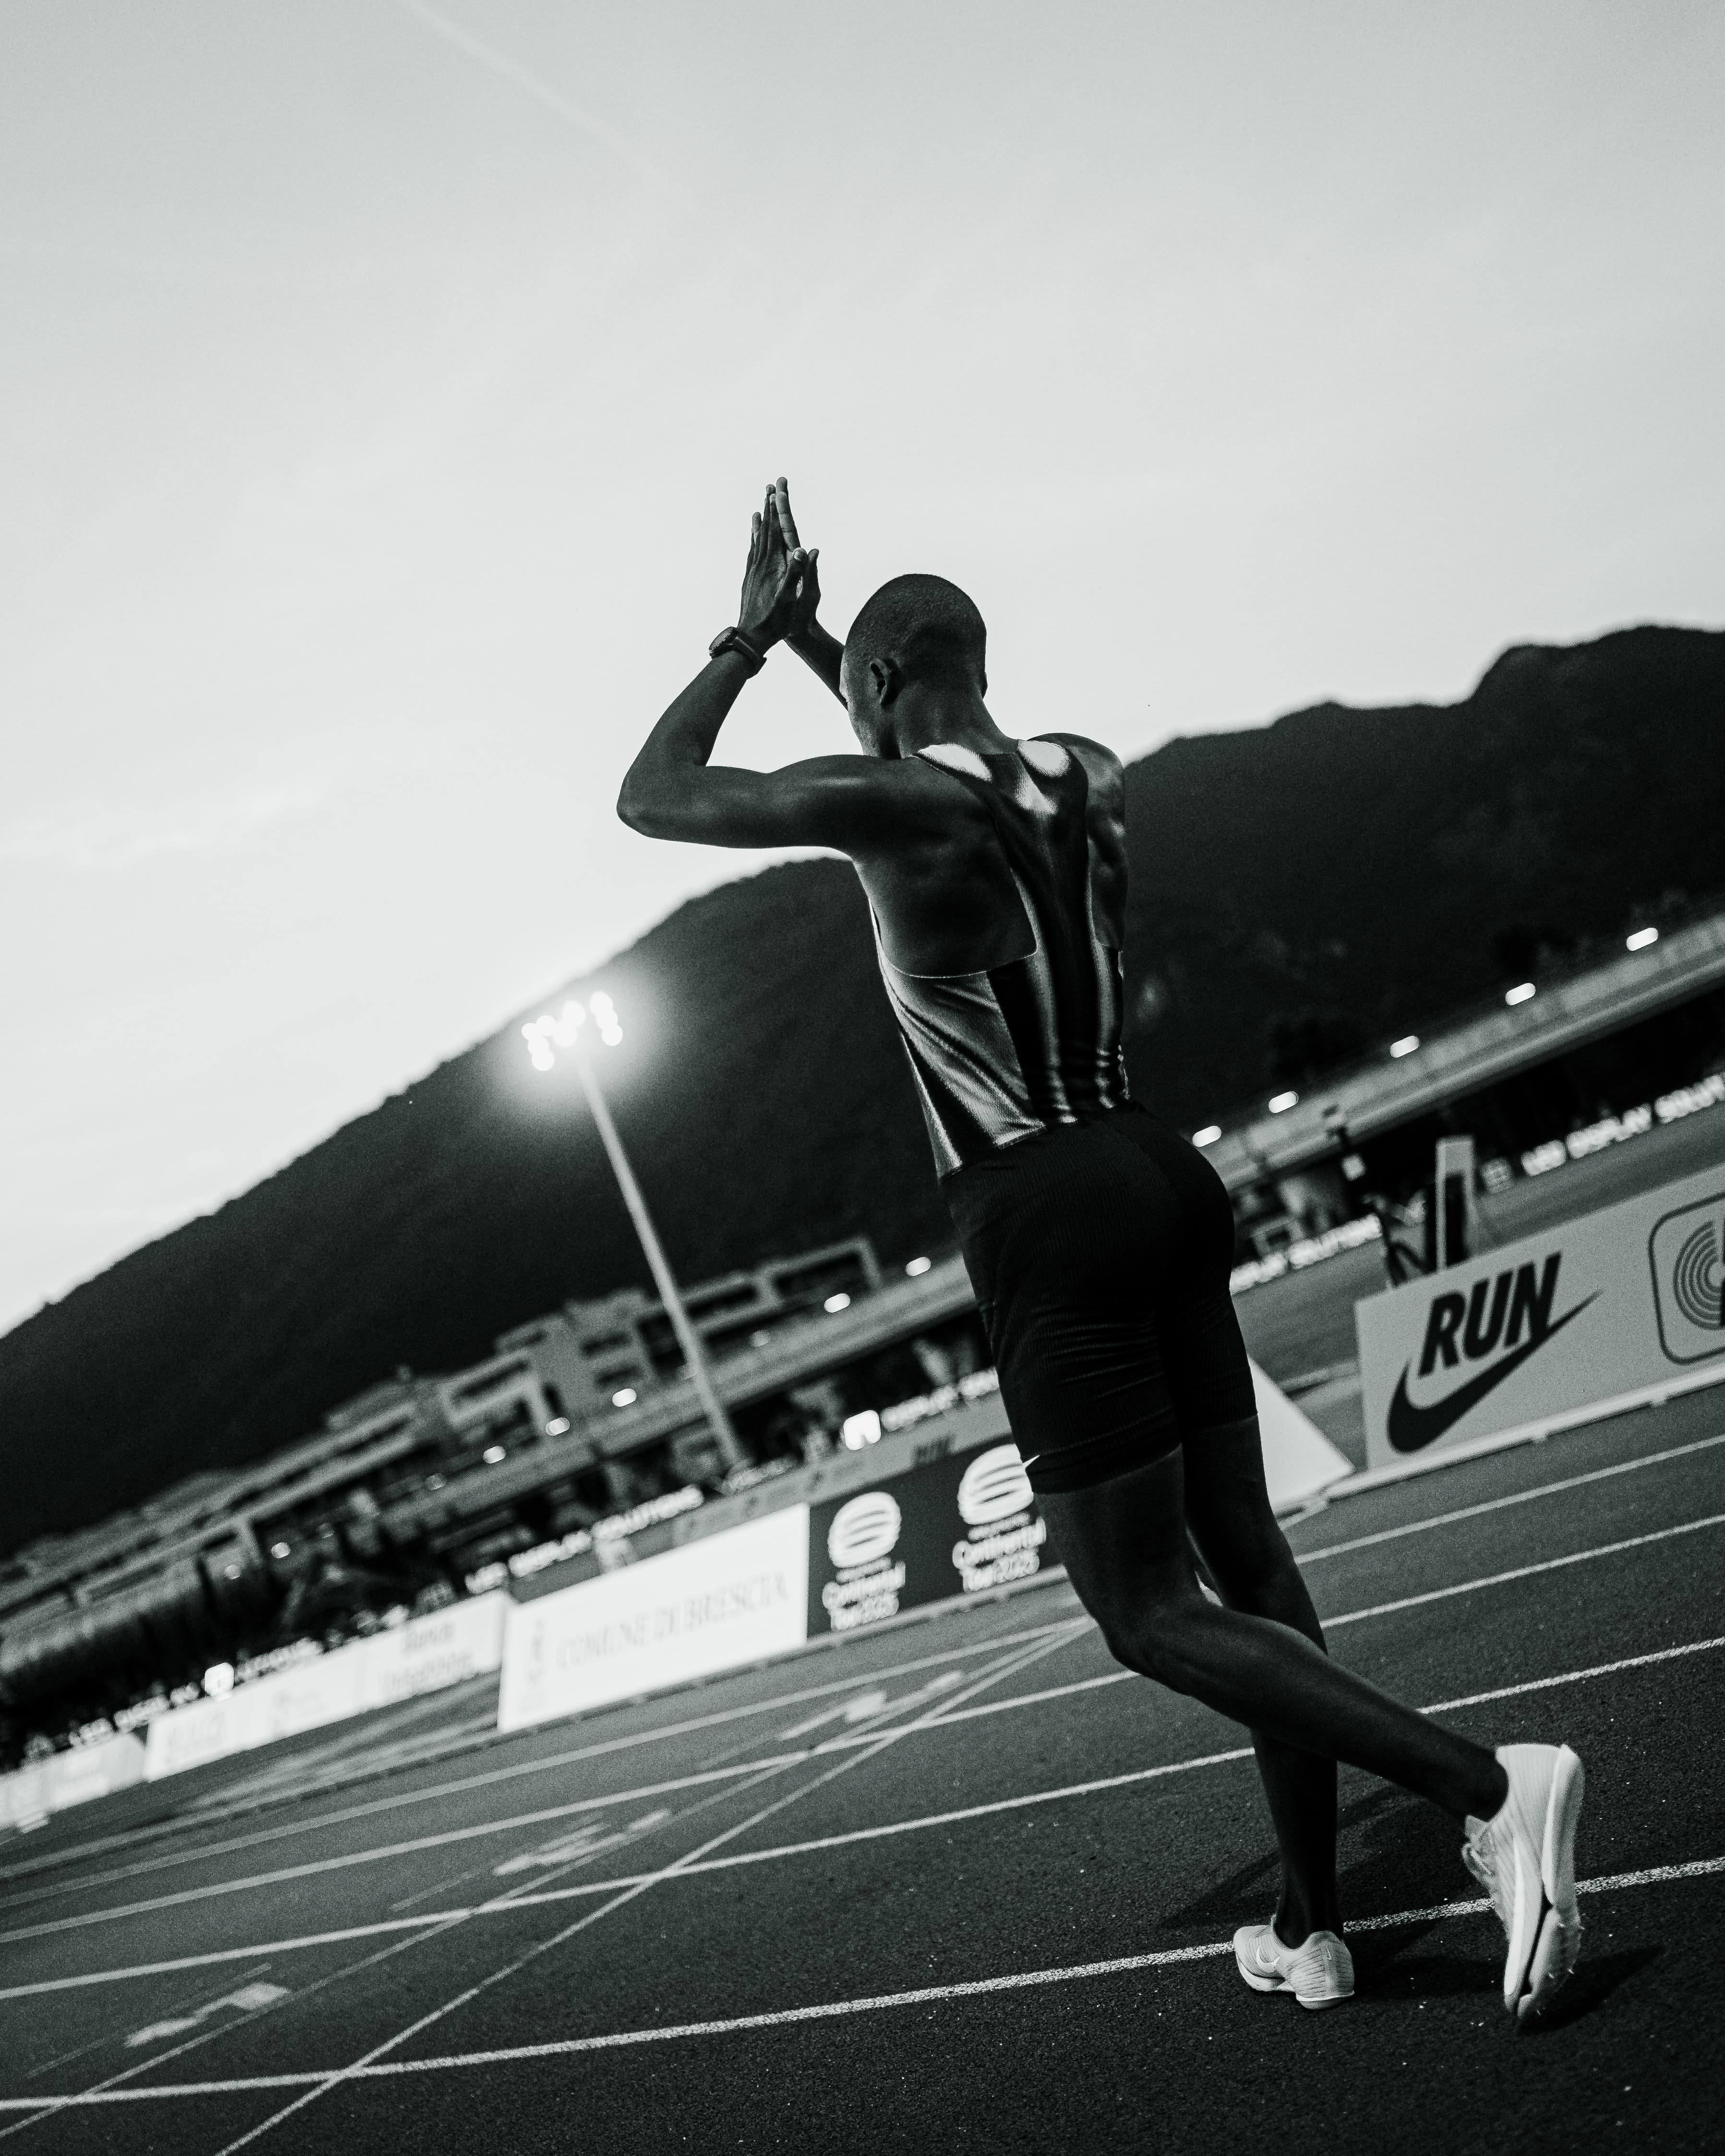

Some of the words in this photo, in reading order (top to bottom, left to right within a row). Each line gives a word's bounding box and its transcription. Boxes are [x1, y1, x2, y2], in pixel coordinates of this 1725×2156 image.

[1418, 1252, 1563, 1377] RUN
[555, 1611, 648, 1672] COMUNE
[653, 1597, 680, 1643] DI
[684, 1571, 789, 1633] BRESCIA
